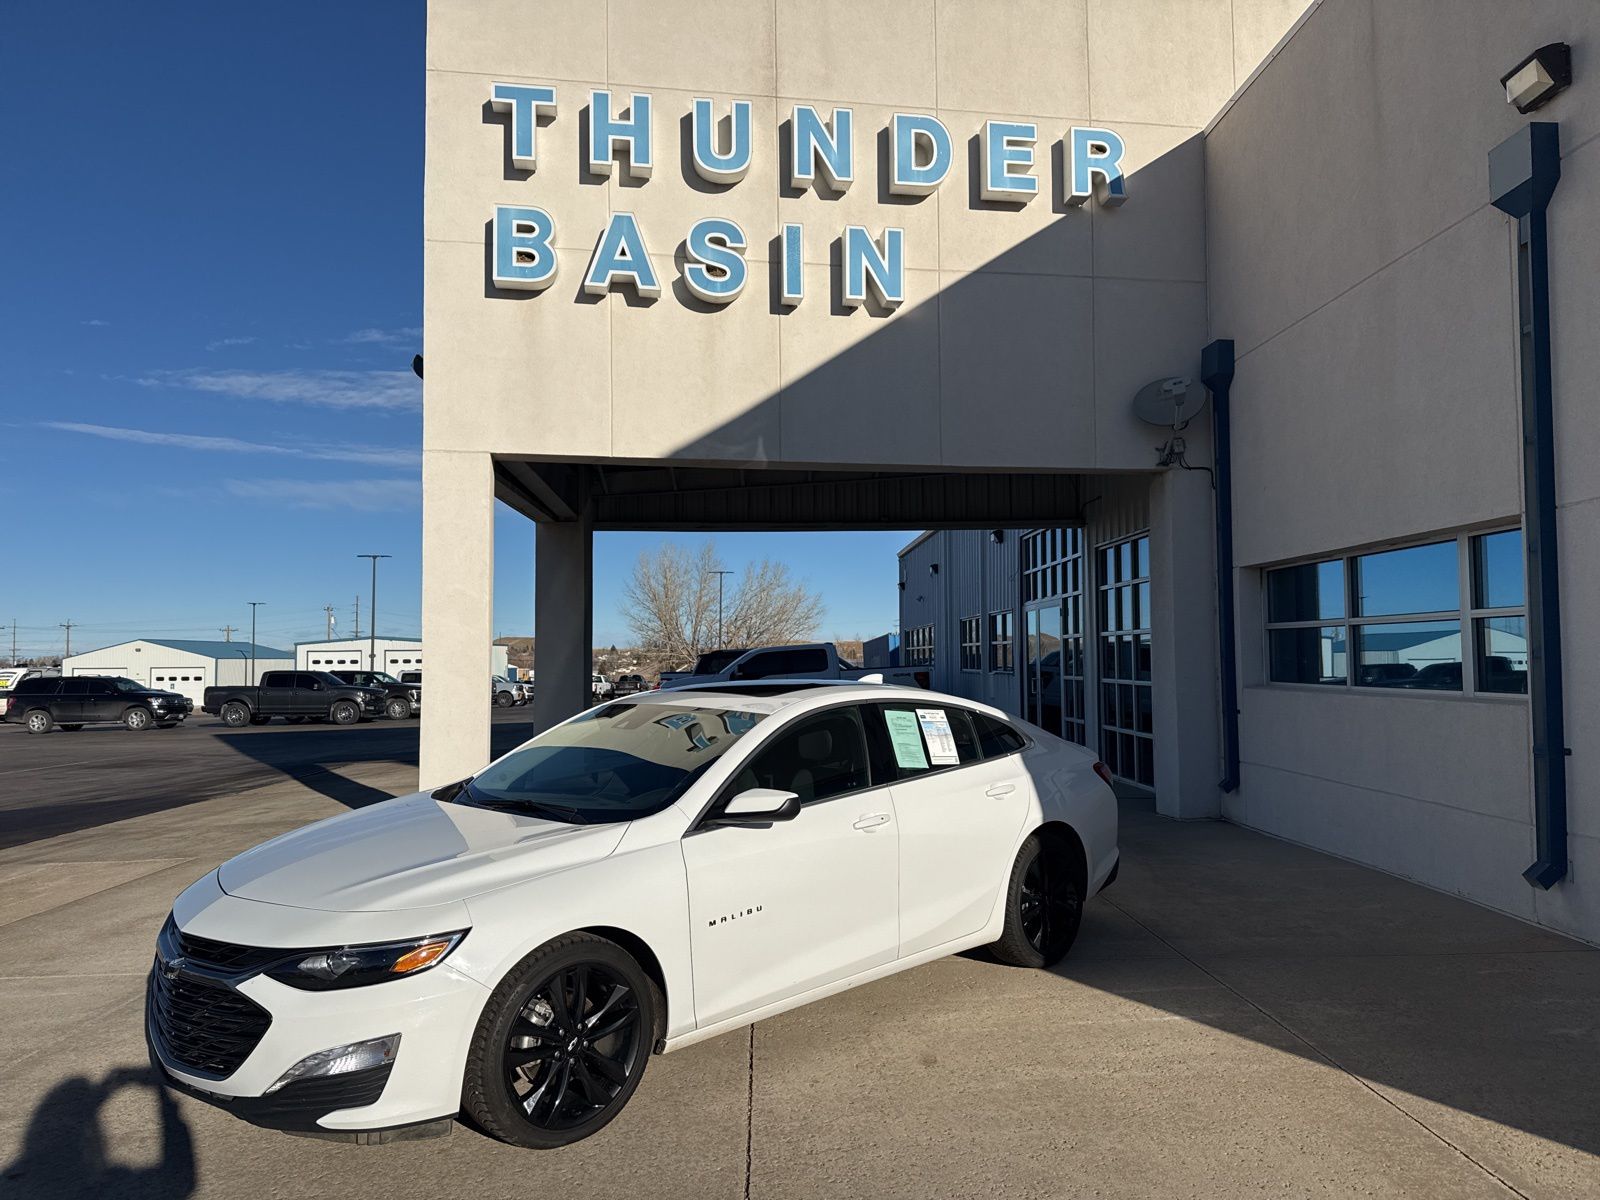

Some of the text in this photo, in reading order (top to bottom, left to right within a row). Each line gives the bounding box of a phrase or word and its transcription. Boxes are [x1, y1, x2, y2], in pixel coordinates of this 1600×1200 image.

[490, 82, 1128, 202] THUNDER
[491, 204, 905, 306] BASIN
[708, 904, 763, 927] MALIBU
